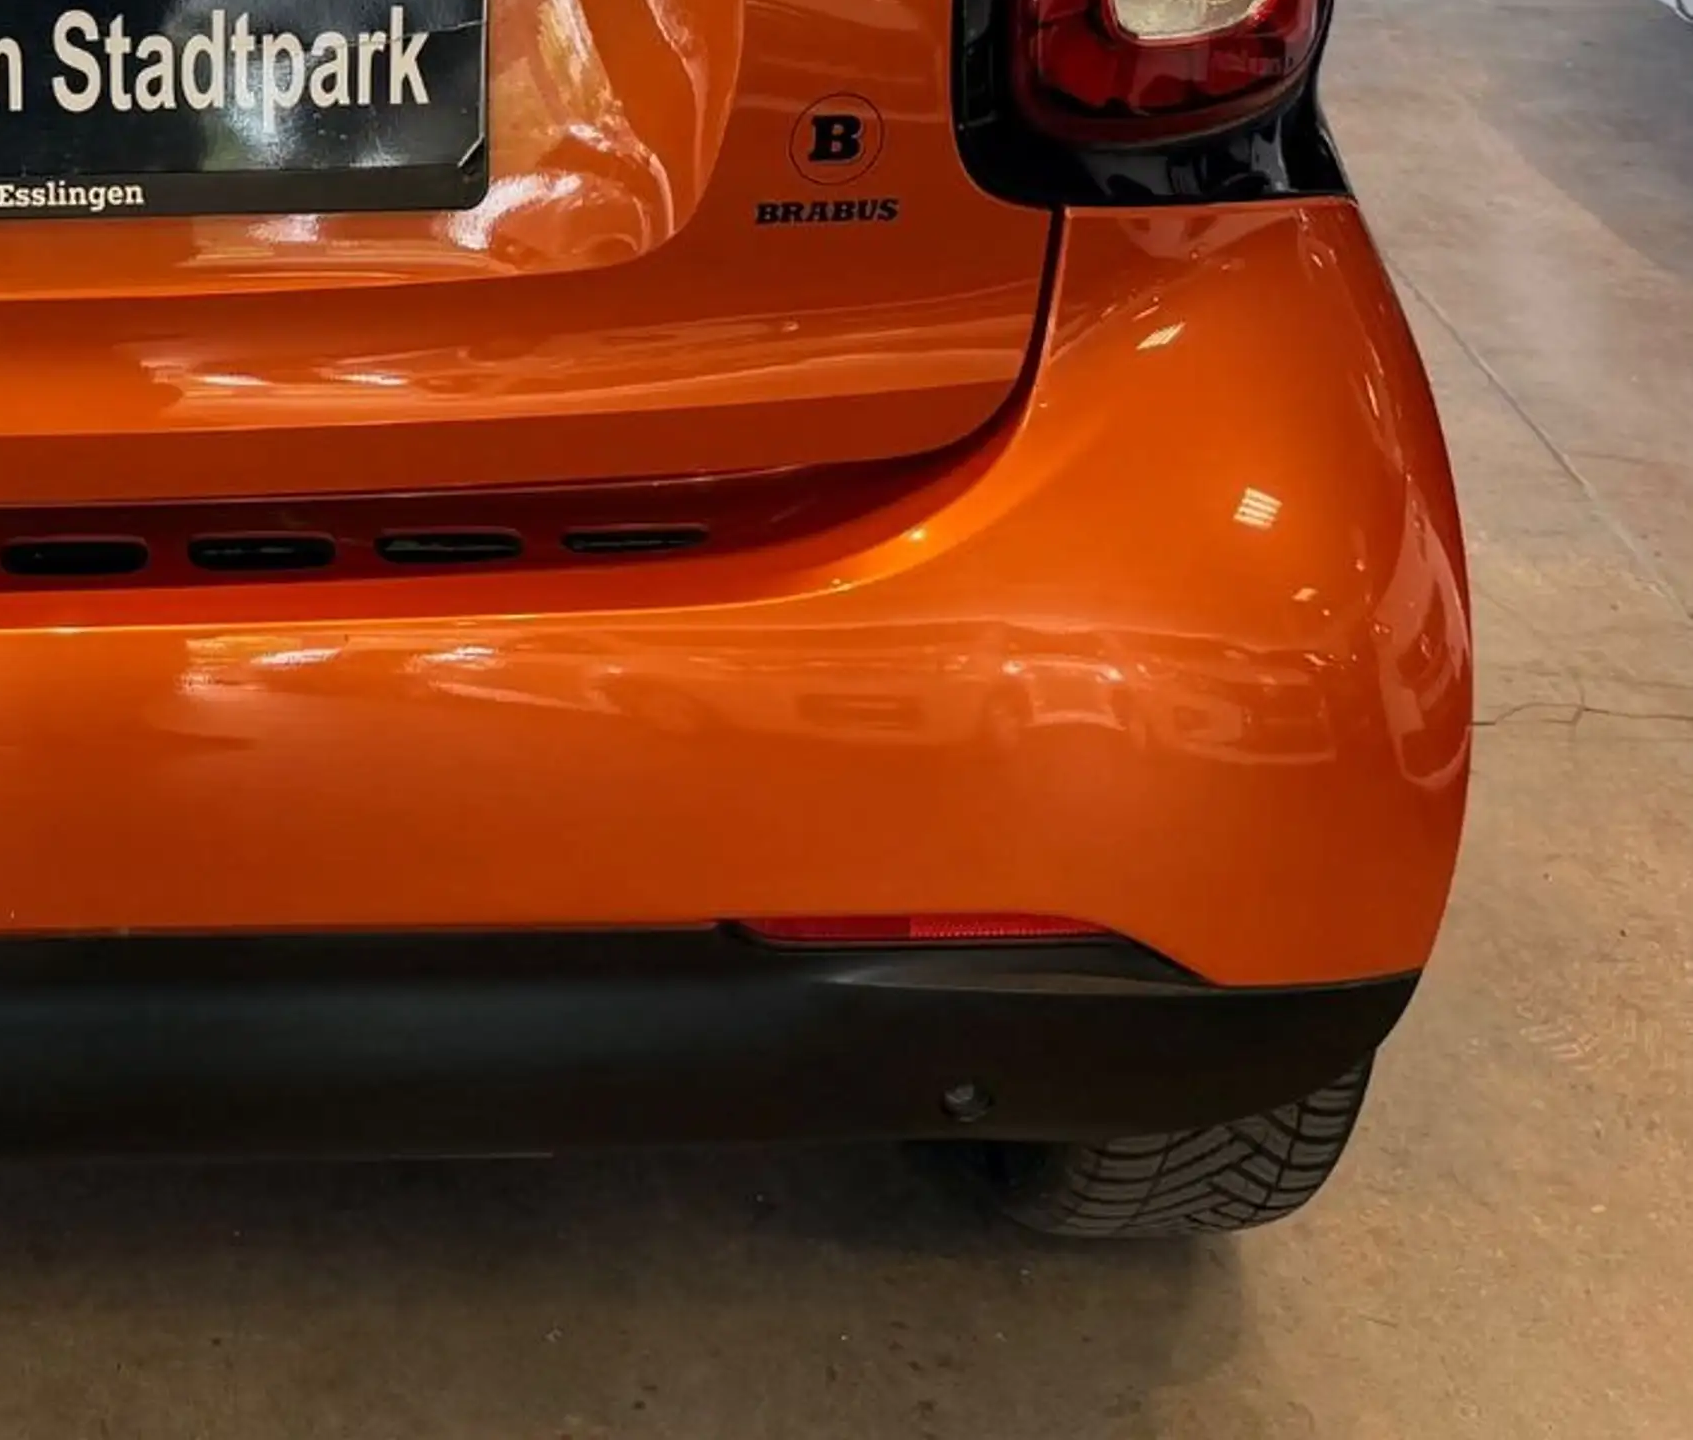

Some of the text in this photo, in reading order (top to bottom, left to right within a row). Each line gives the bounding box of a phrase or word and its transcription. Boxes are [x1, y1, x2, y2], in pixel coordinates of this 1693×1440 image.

[51, 6, 430, 133] Stadtpark
[810, 115, 863, 161] B
[755, 198, 900, 225] BRABUS
